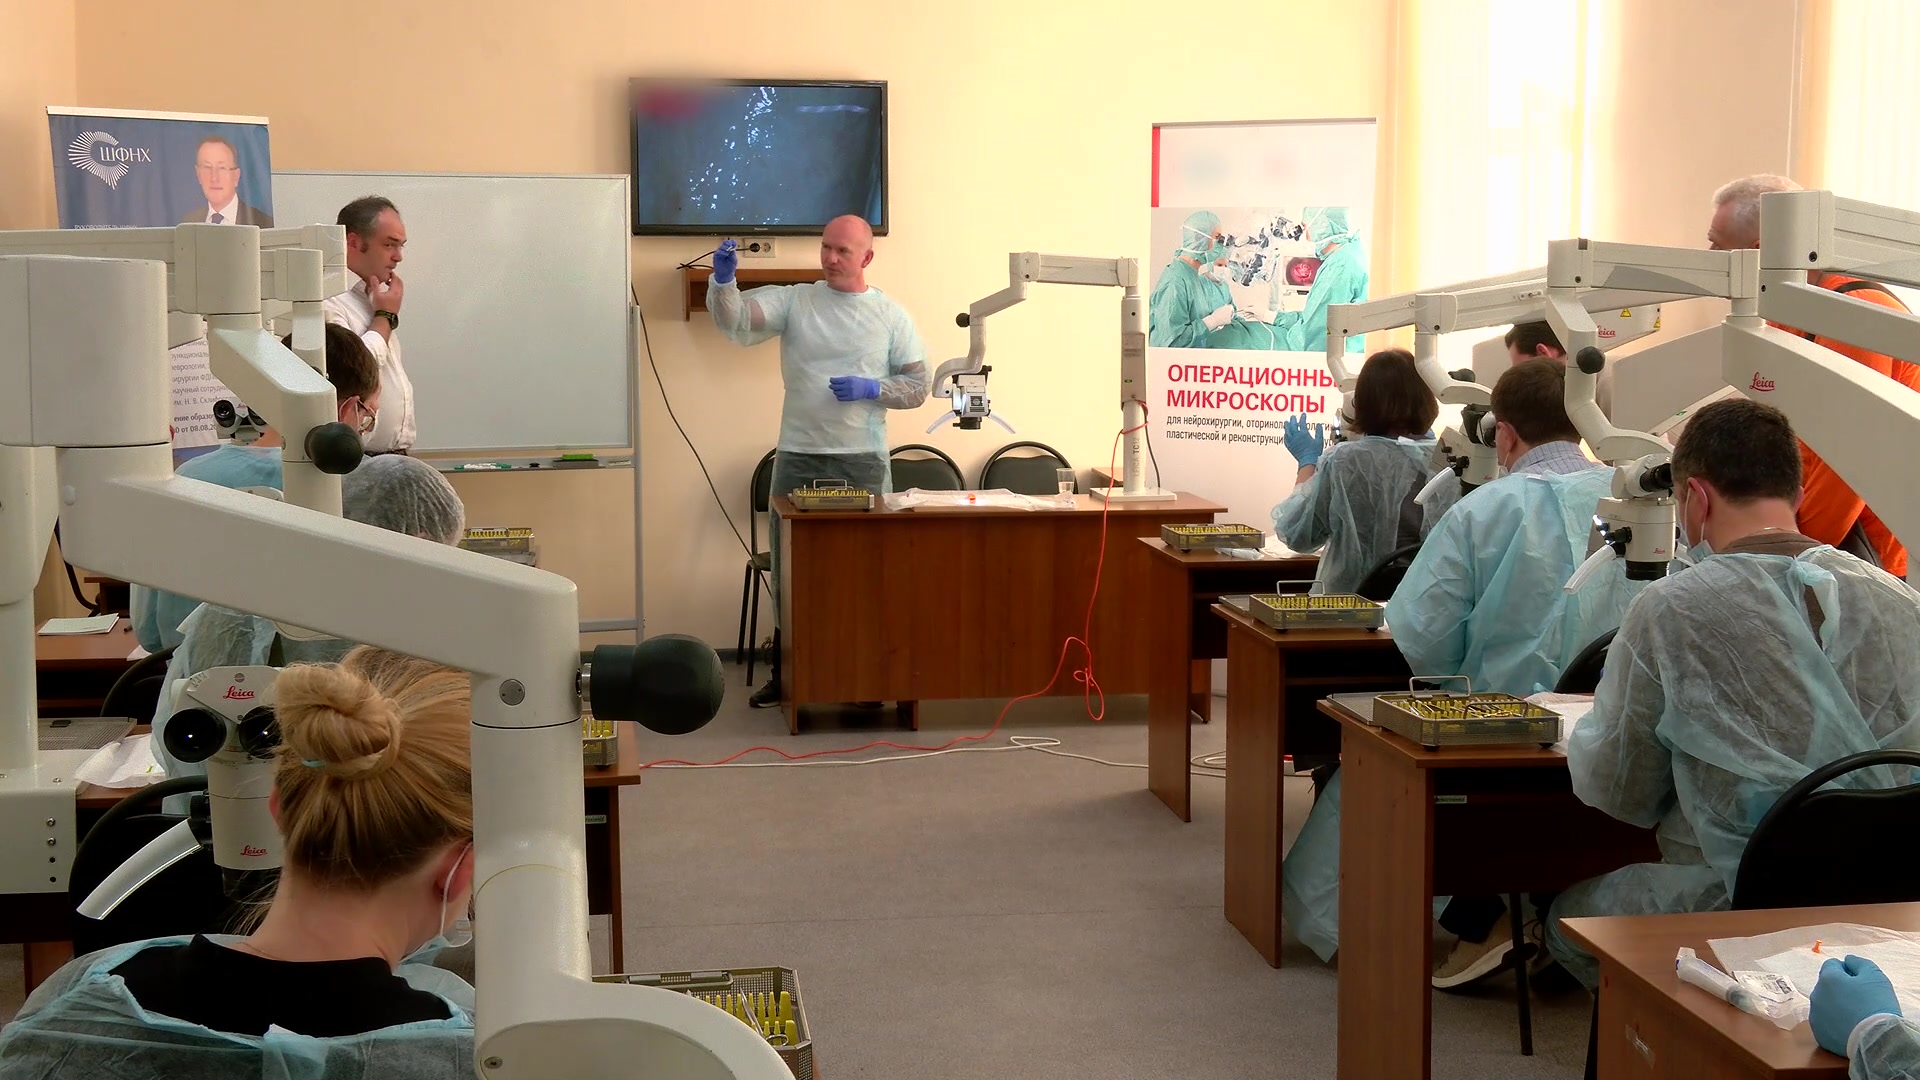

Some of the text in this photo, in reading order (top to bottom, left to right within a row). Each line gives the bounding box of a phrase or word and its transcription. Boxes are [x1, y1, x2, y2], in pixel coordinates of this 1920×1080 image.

[100, 146, 151, 162] ШФНХ
[1168, 364, 1339, 388] ОПЕРАЦИОННЫ
[1749, 371, 1775, 391] Leica
[1167, 389, 1325, 413] МИКРОСКОПЫ
[190, 412, 213, 422] образо
[1166, 415, 1182, 425] для
[1183, 415, 1244, 429] нейрохирургии,
[1166, 430, 1284, 446] пластической и реконструкци
[223, 685, 255, 700] Leica
[240, 844, 268, 857] Leica
